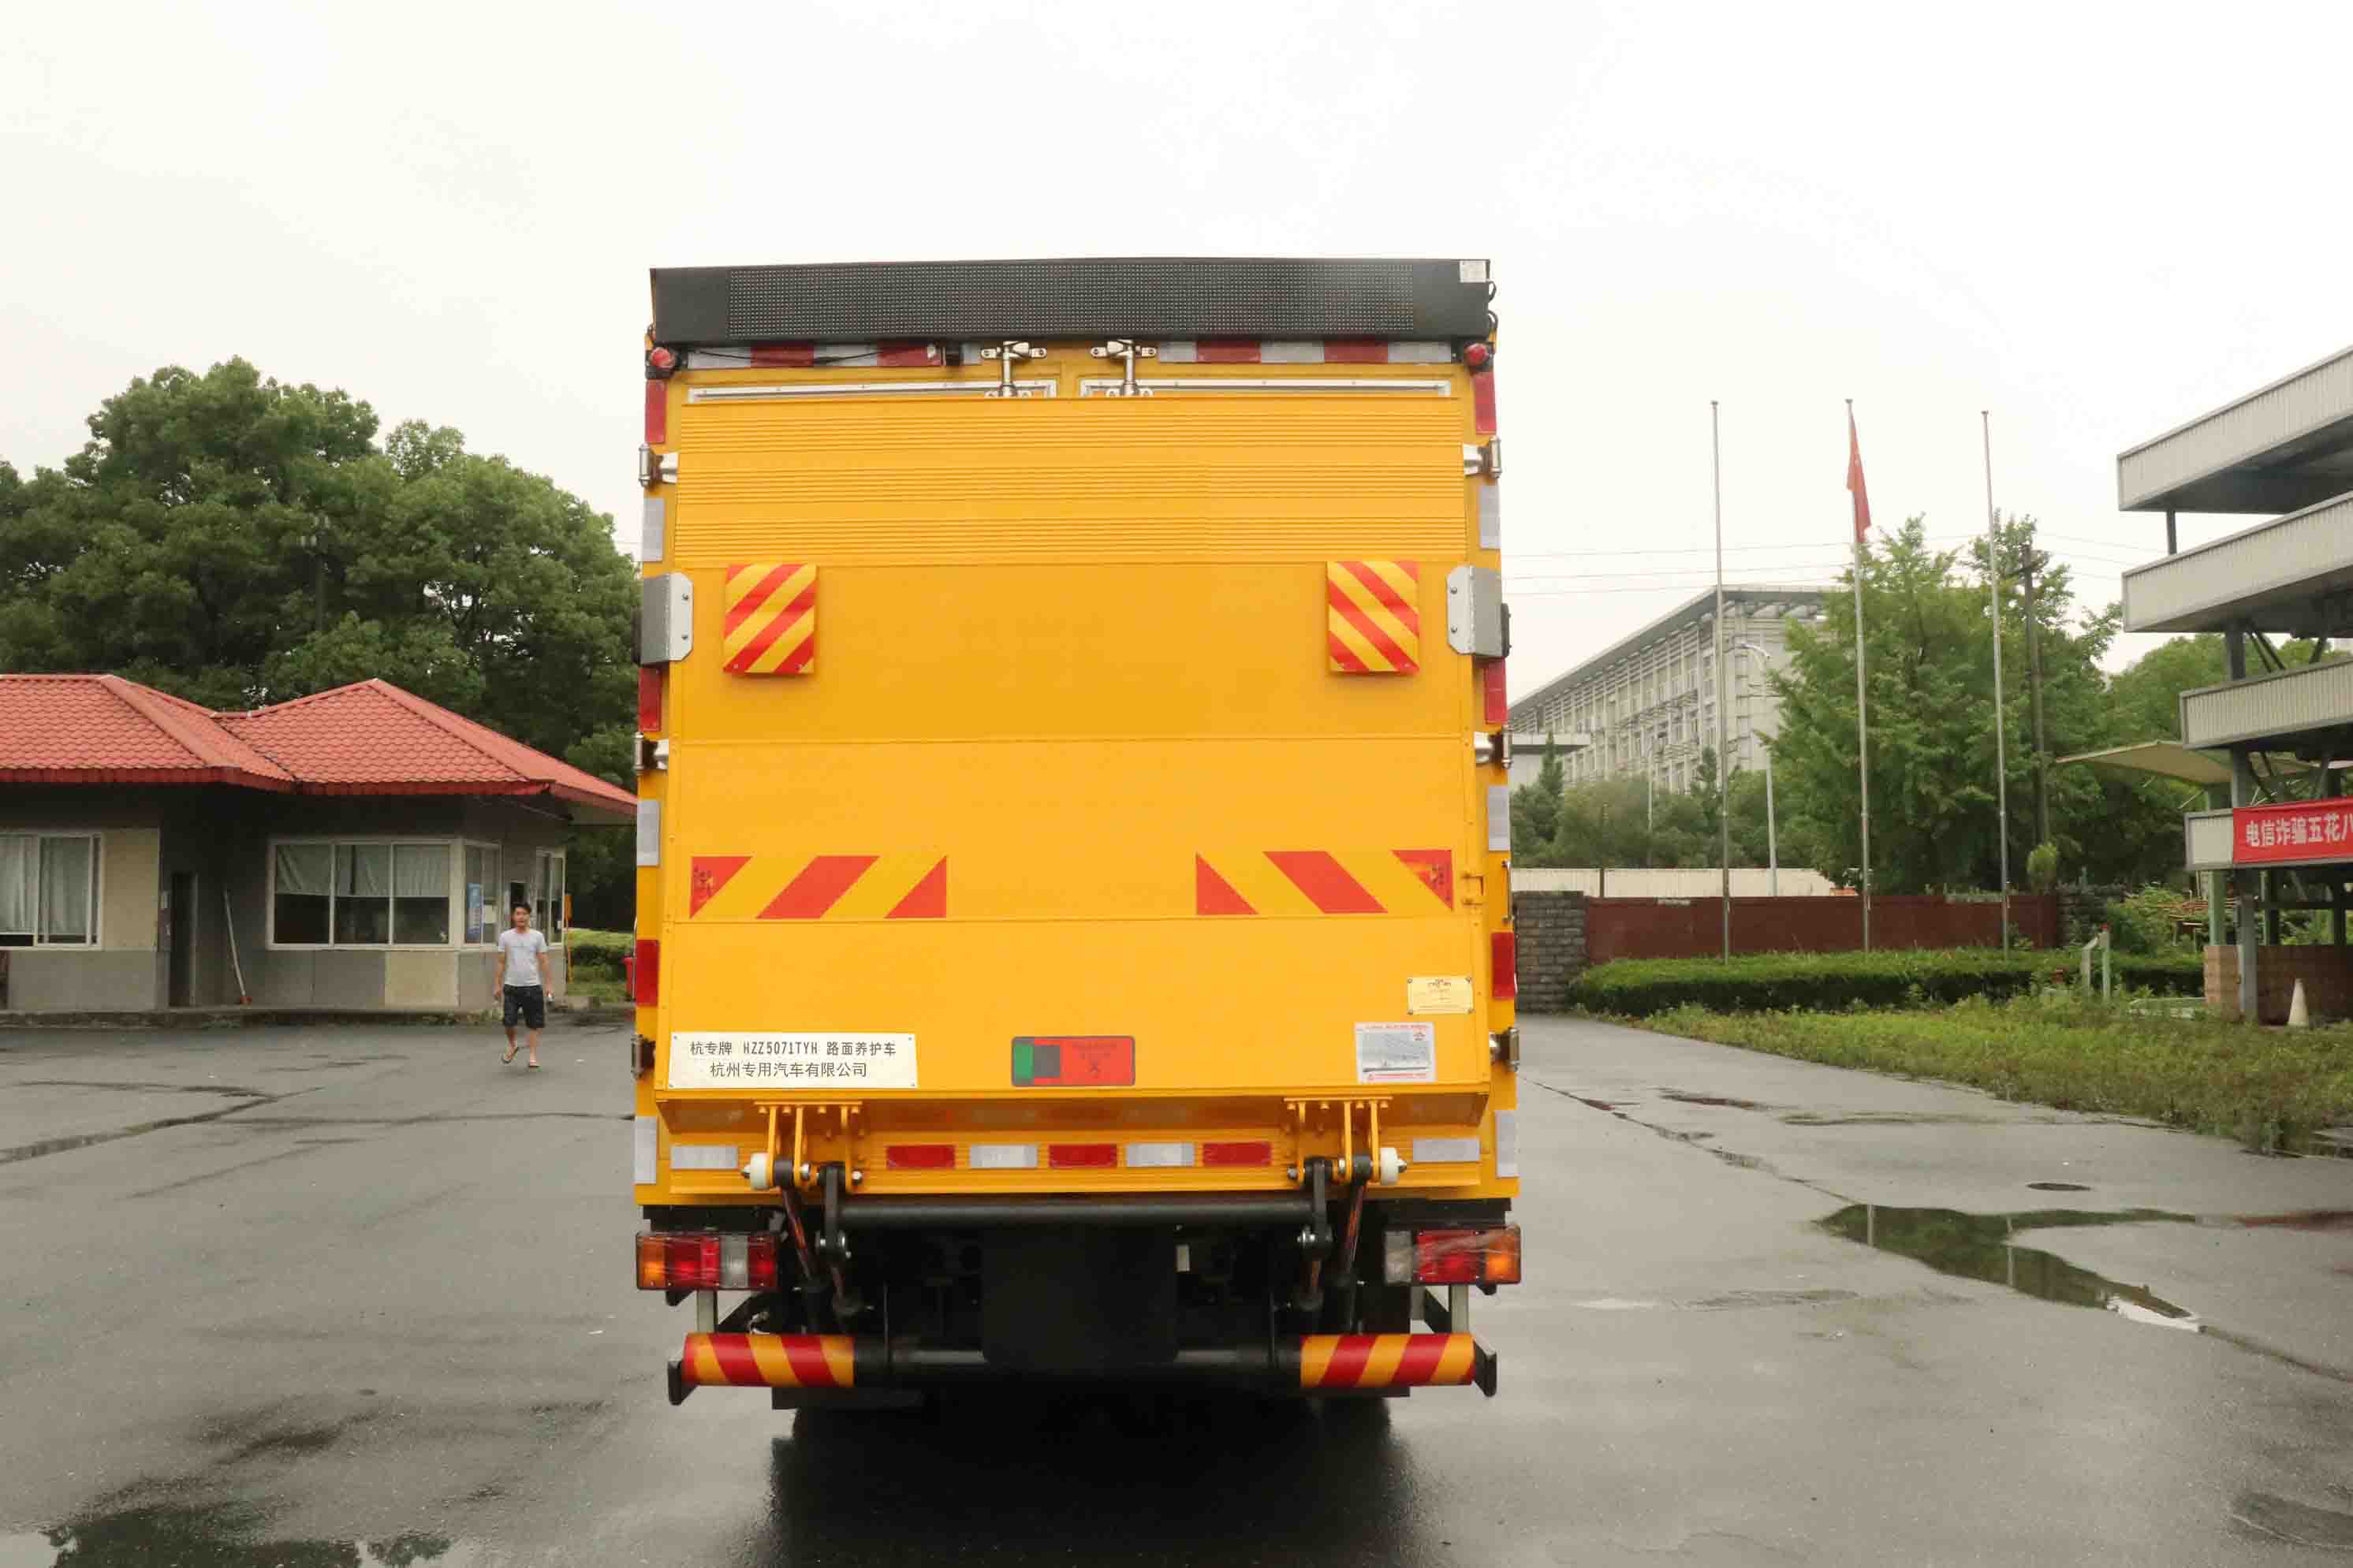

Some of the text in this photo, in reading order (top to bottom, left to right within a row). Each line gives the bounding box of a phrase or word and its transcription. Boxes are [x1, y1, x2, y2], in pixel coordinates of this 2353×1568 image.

[690, 1041, 897, 1056] 杭专牌 HZZ5071TYH 路面养护车
[710, 1061, 867, 1078] 杭州专用汽车有限公司
